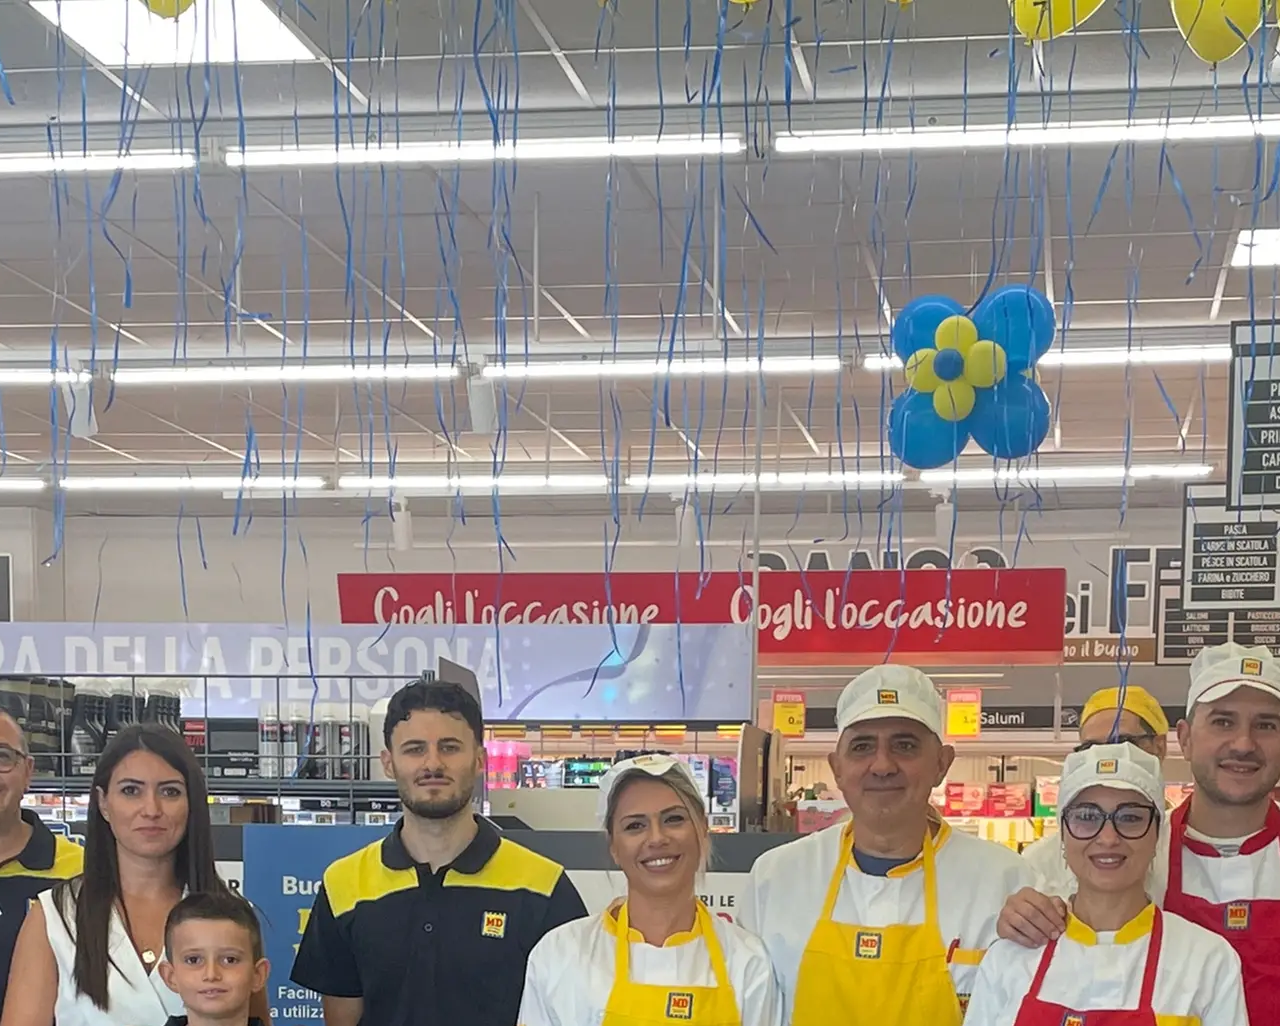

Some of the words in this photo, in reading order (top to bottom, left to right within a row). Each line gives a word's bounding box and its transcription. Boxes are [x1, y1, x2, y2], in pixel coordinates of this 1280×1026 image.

[1236, 539, 1269, 550] SCATOLA
[1226, 556, 1235, 566] IN
[1235, 556, 1268, 567] SCATOLA
[1198, 572, 1224, 583] FARINA
[1232, 571, 1270, 582] ZUCCHERO
[730, 585, 812, 640] Cogli
[825, 588, 1028, 629] l'occasione
[981, 712, 1025, 725] Salumi
[720, 895, 735, 907] LE
[1229, 907, 1246, 919] MD
[486, 916, 503, 928] MD
[860, 938, 877, 949] MD
[672, 998, 688, 1008] MD
